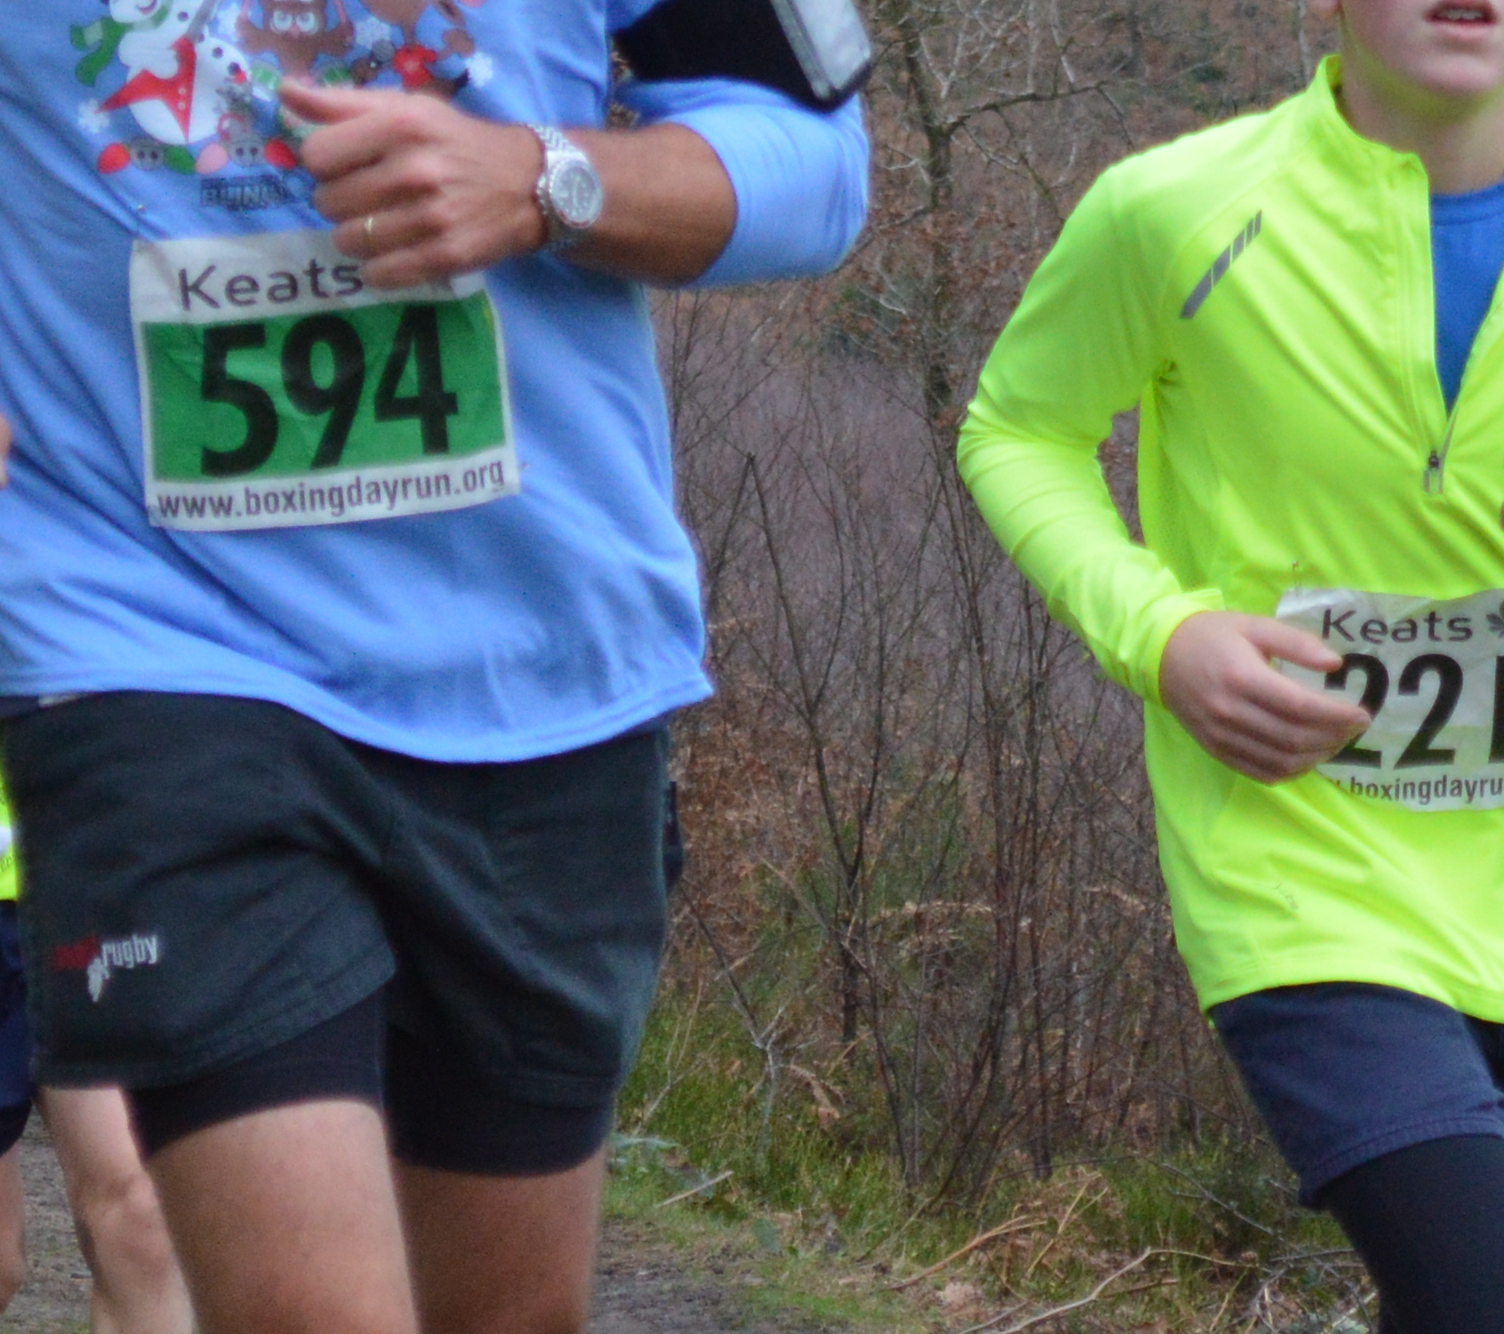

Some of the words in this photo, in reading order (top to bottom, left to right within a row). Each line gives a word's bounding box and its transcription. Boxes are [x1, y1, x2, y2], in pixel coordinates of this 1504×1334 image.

[178, 258, 365, 312] Keats
[199, 304, 459, 479] 594
[157, 458, 506, 519] www.boxingdayrun.org
[1321, 608, 1475, 645] Keats
[101, 933, 160, 969] rugby
